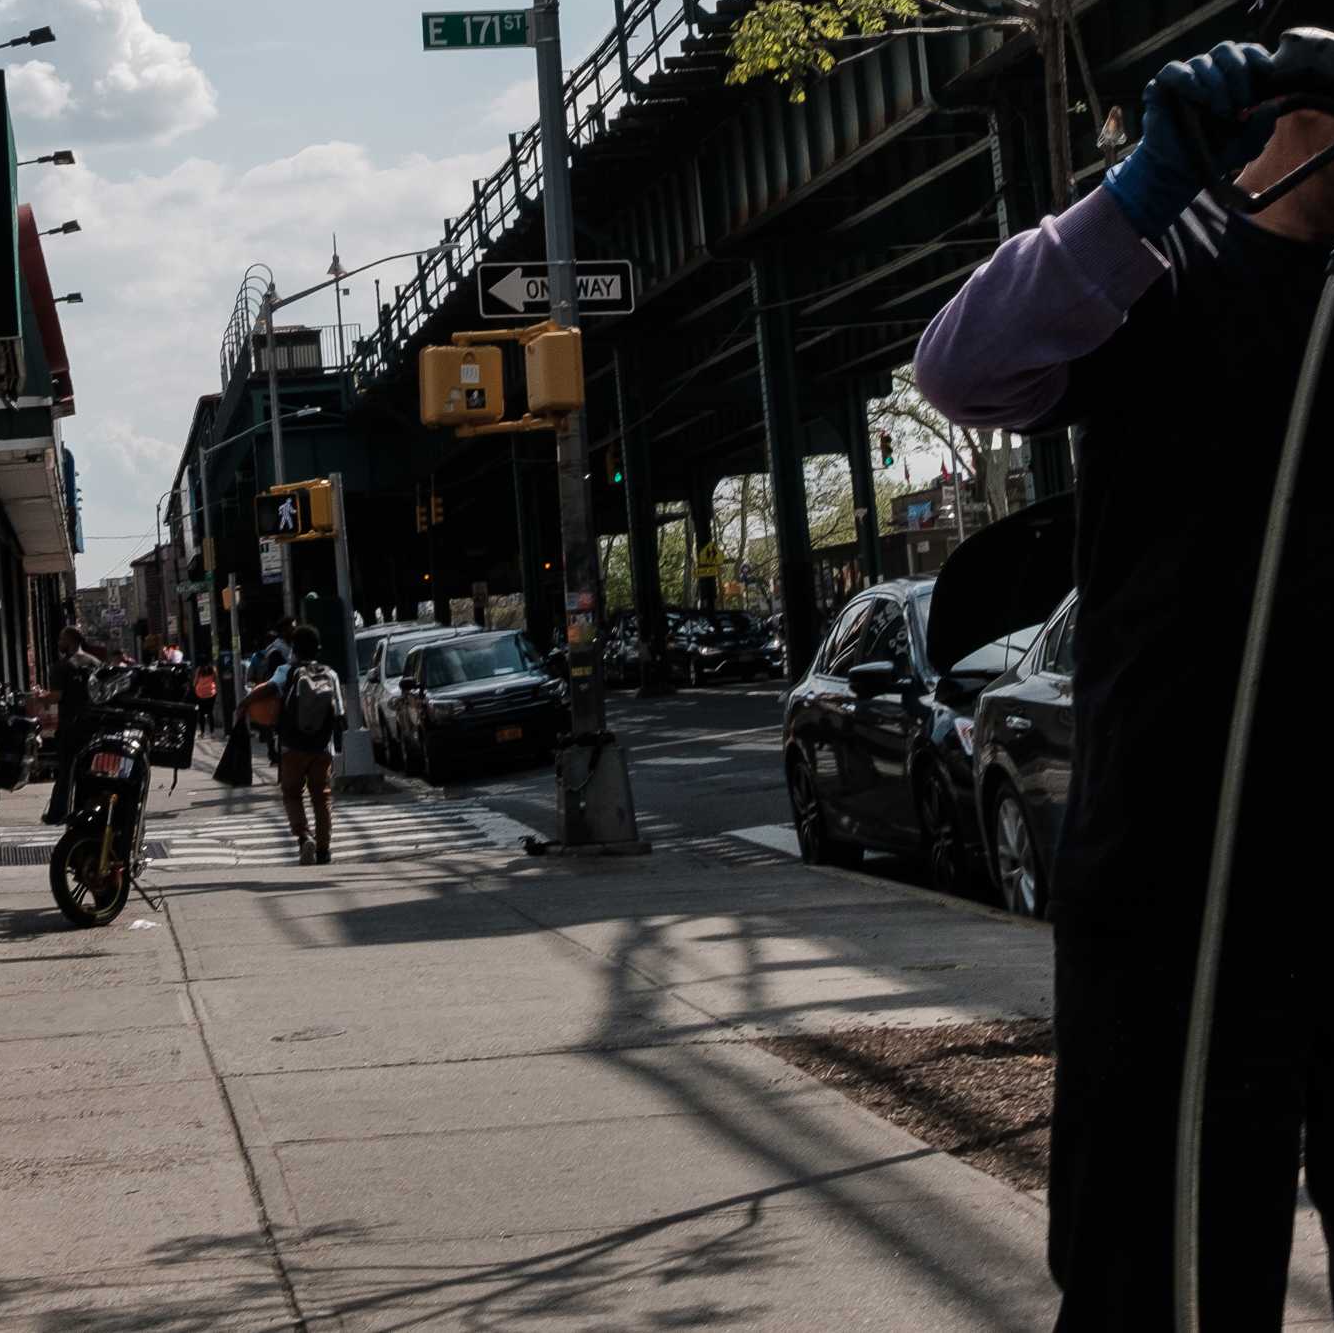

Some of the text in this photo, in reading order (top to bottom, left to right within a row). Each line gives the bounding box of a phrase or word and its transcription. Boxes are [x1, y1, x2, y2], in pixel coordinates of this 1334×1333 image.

[428, 17, 449, 46] E
[526, 278, 615, 299] ON WAY
